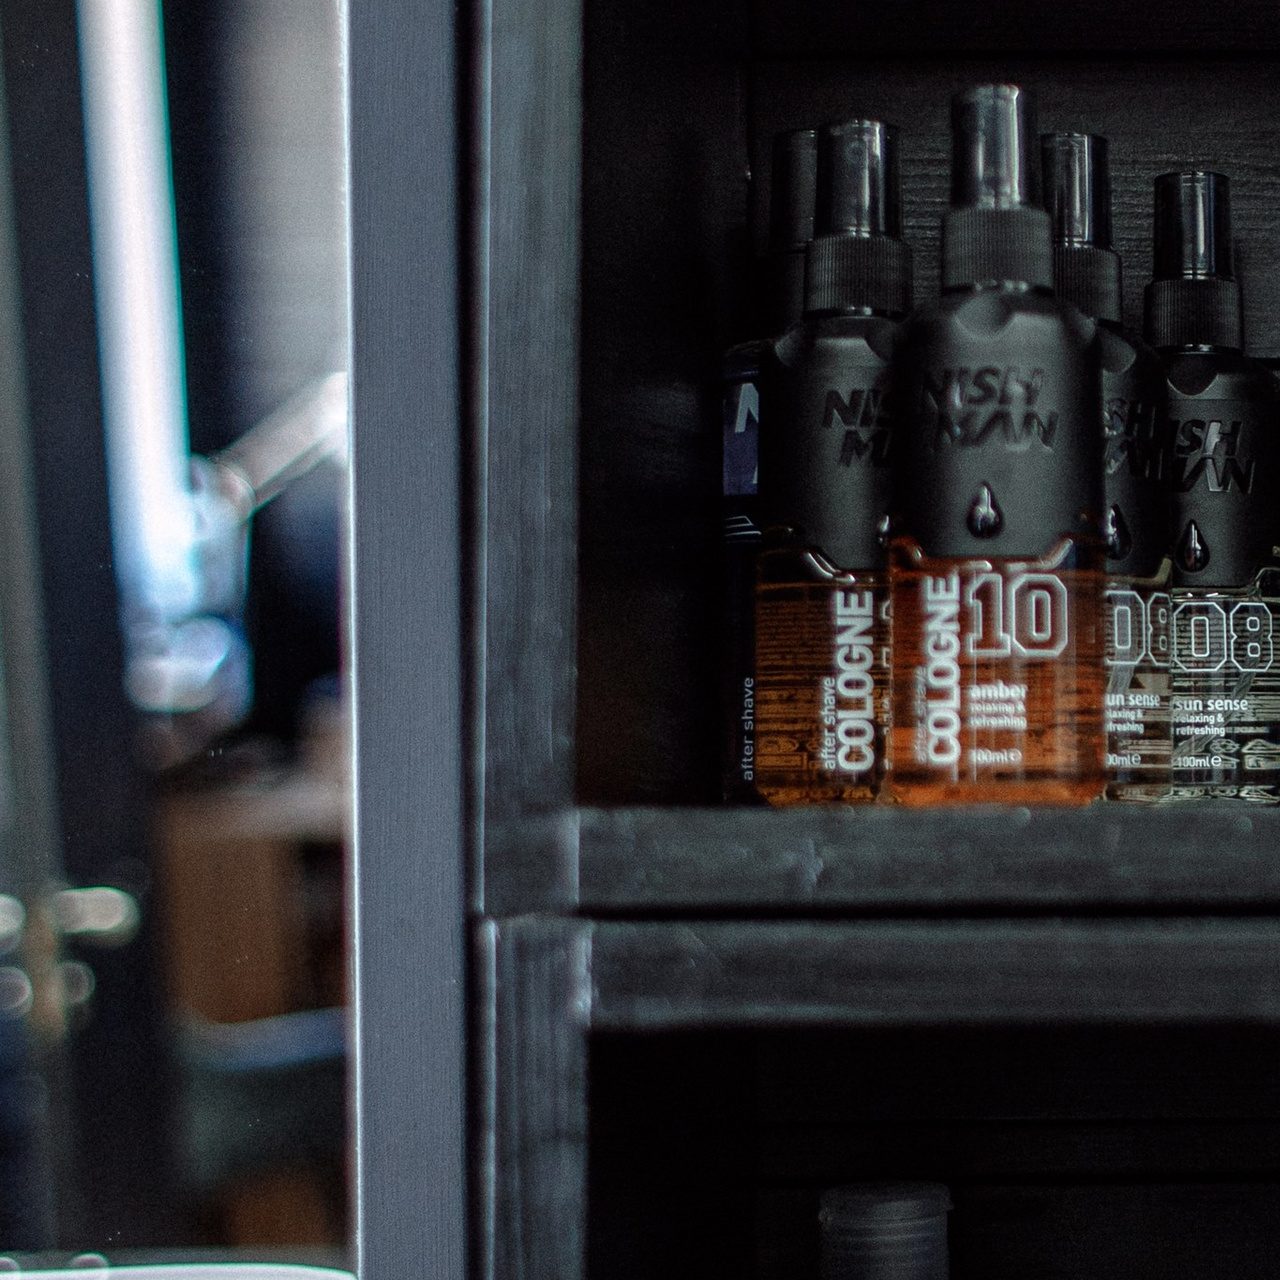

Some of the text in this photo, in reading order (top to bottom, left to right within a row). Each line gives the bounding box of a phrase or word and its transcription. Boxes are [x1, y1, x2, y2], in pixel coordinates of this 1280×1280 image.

[966, 573, 1068, 657] 10
[1173, 602, 1273, 672] 08
[836, 590, 875, 772] COLOGNE
[926, 572, 961, 764] COLOGNE
[970, 679, 1028, 698] amber
[1106, 693, 1160, 707] un sense
[742, 677, 754, 781] after shave
[820, 677, 836, 770] after shave
[1176, 699, 1248, 711] sun sense
[1176, 725, 1226, 737] refreshing
[1177, 713, 1224, 724] relaxing &
